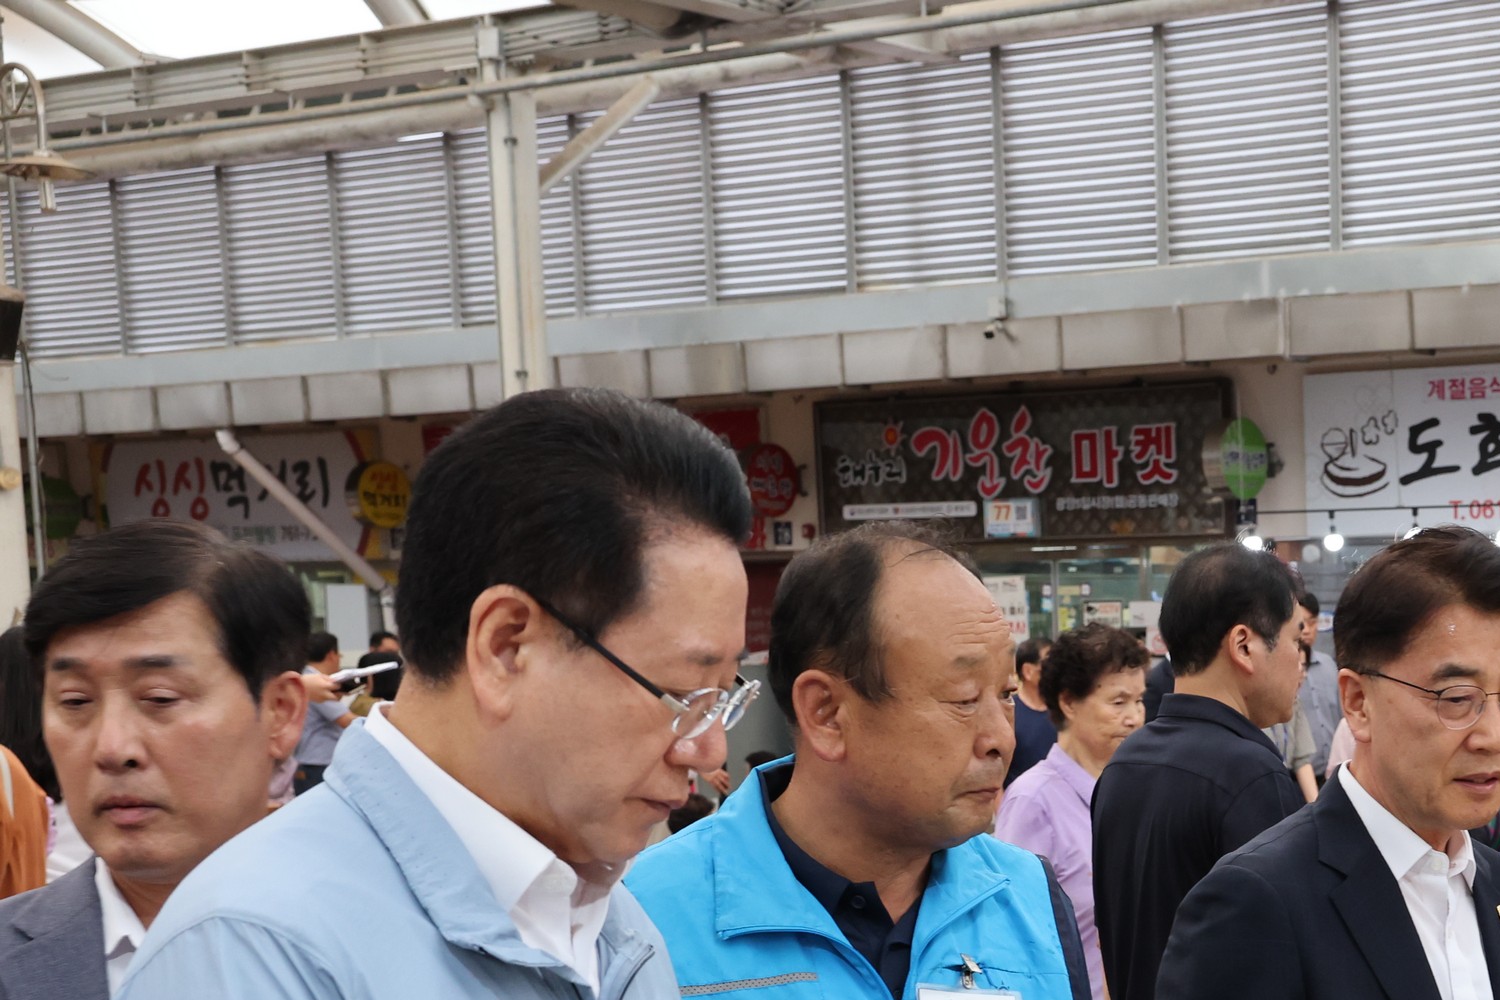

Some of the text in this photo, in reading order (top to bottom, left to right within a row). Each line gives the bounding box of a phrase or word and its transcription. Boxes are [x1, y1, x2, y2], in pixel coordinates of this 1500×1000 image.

[911, 405, 1053, 497] 기운찬
[1070, 423, 1178, 488] 마켓
[993, 504, 1012, 521] 77
